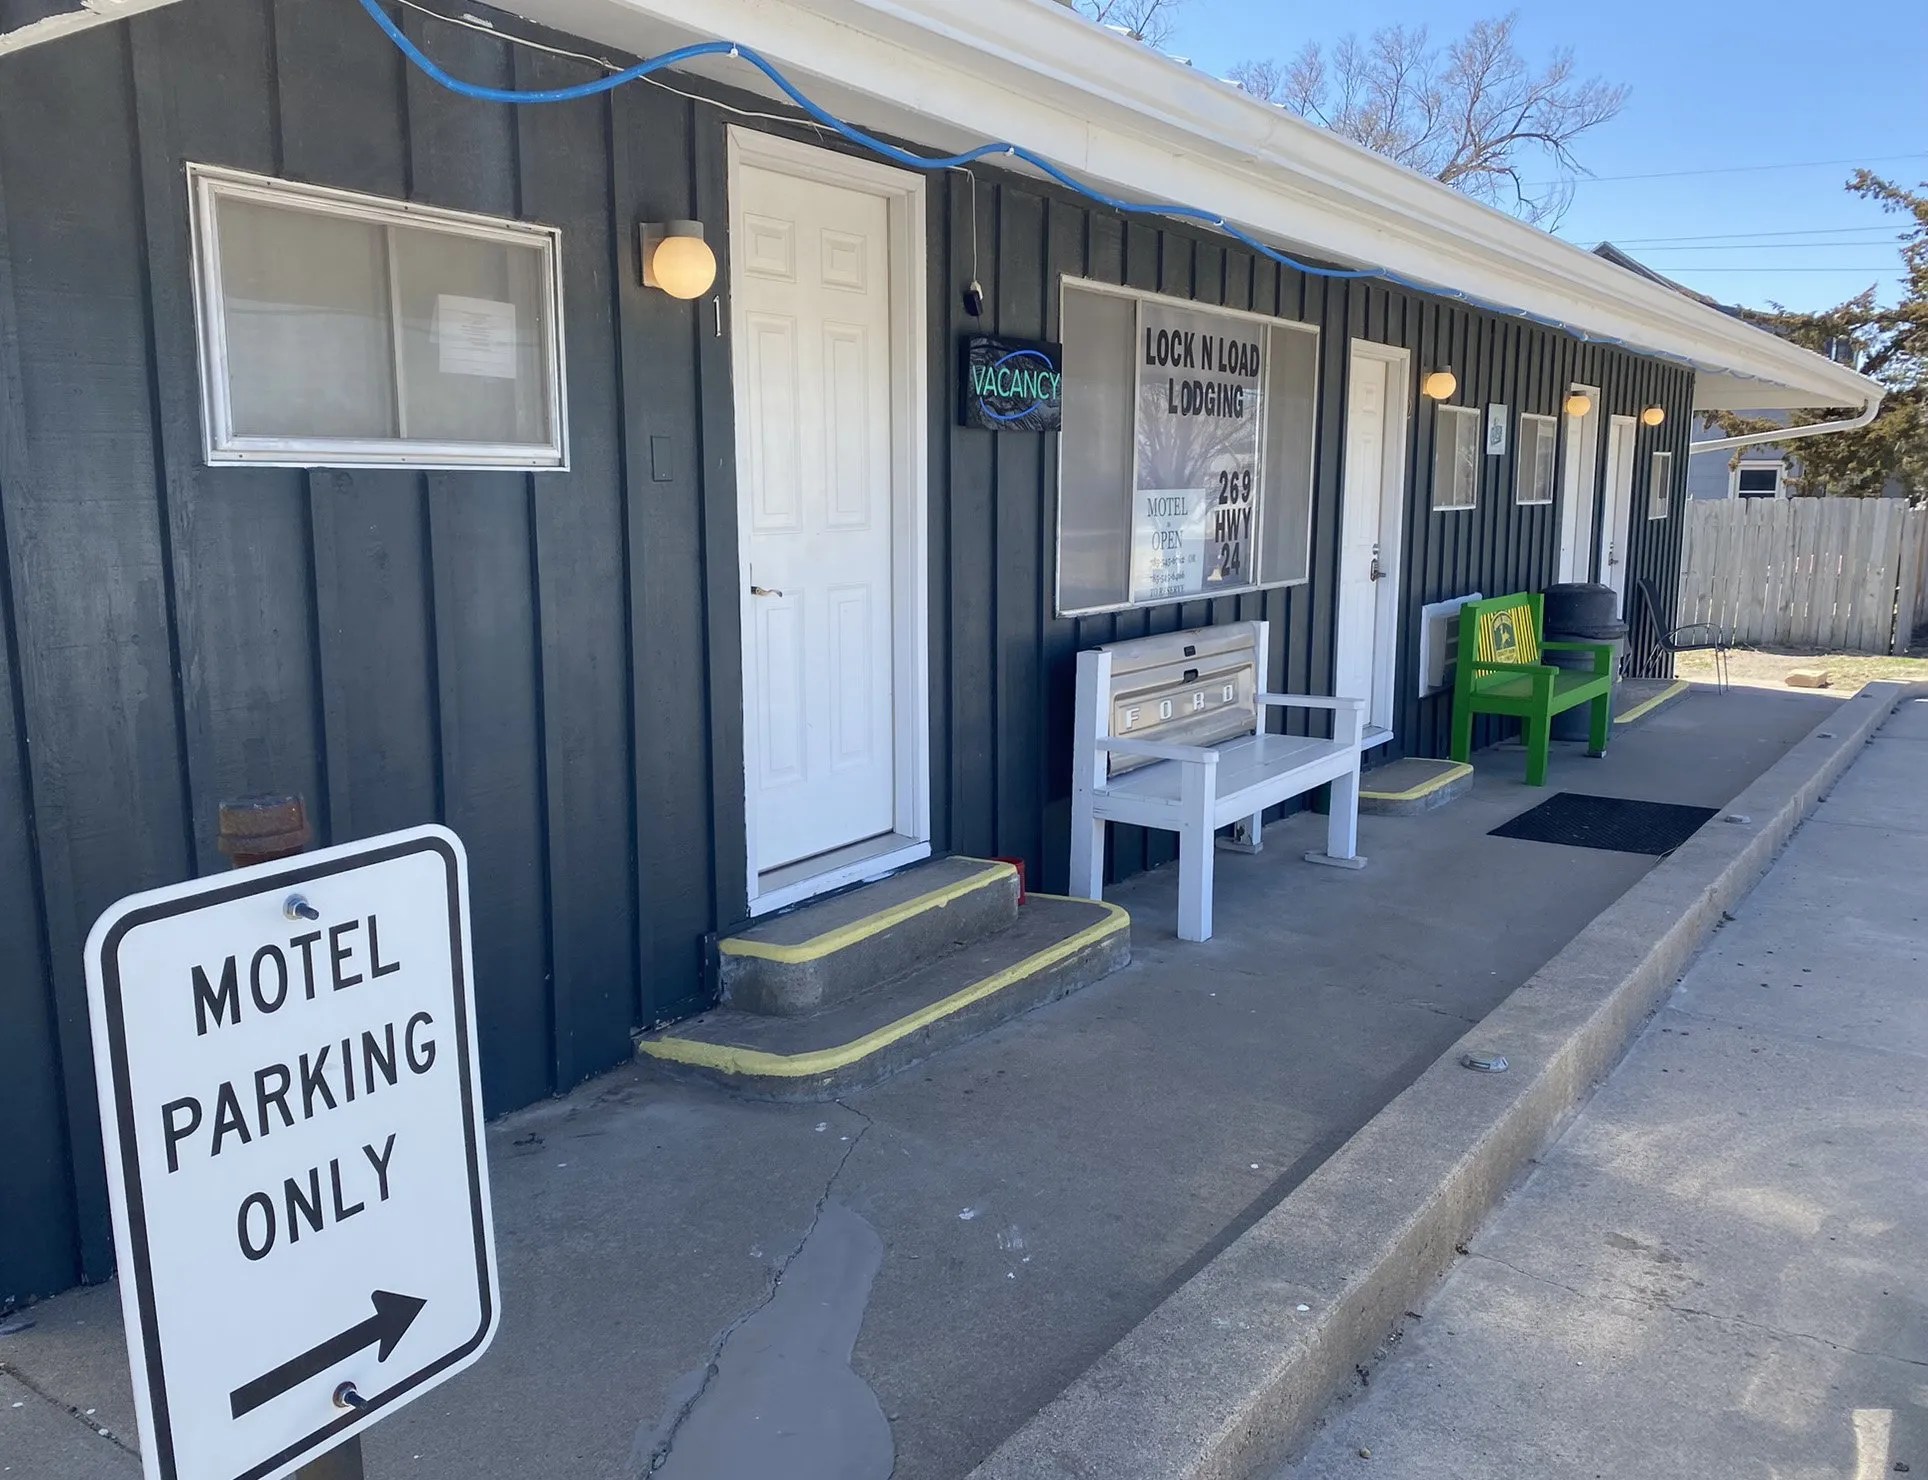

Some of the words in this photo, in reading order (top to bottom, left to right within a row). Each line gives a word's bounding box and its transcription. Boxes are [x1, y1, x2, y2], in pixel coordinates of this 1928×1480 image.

[1146, 327, 1195, 368] LOCK
[1201, 334, 1213, 370] N
[1218, 337, 1260, 377] LOAD
[972, 365, 1060, 400] VACANCY
[1168, 378, 1244, 419] LODGING
[1147, 497, 1188, 517] MOTEL
[1218, 470, 1251, 505] 269
[1152, 530, 1183, 551] OPEN
[1215, 506, 1252, 543] HWY
[1220, 542, 1240, 577] 24
[1125, 684, 1233, 730] FORD
[191, 914, 401, 1037] MOTEL
[161, 1011, 437, 1175] PARKING
[237, 1132, 397, 1262] ONLY
